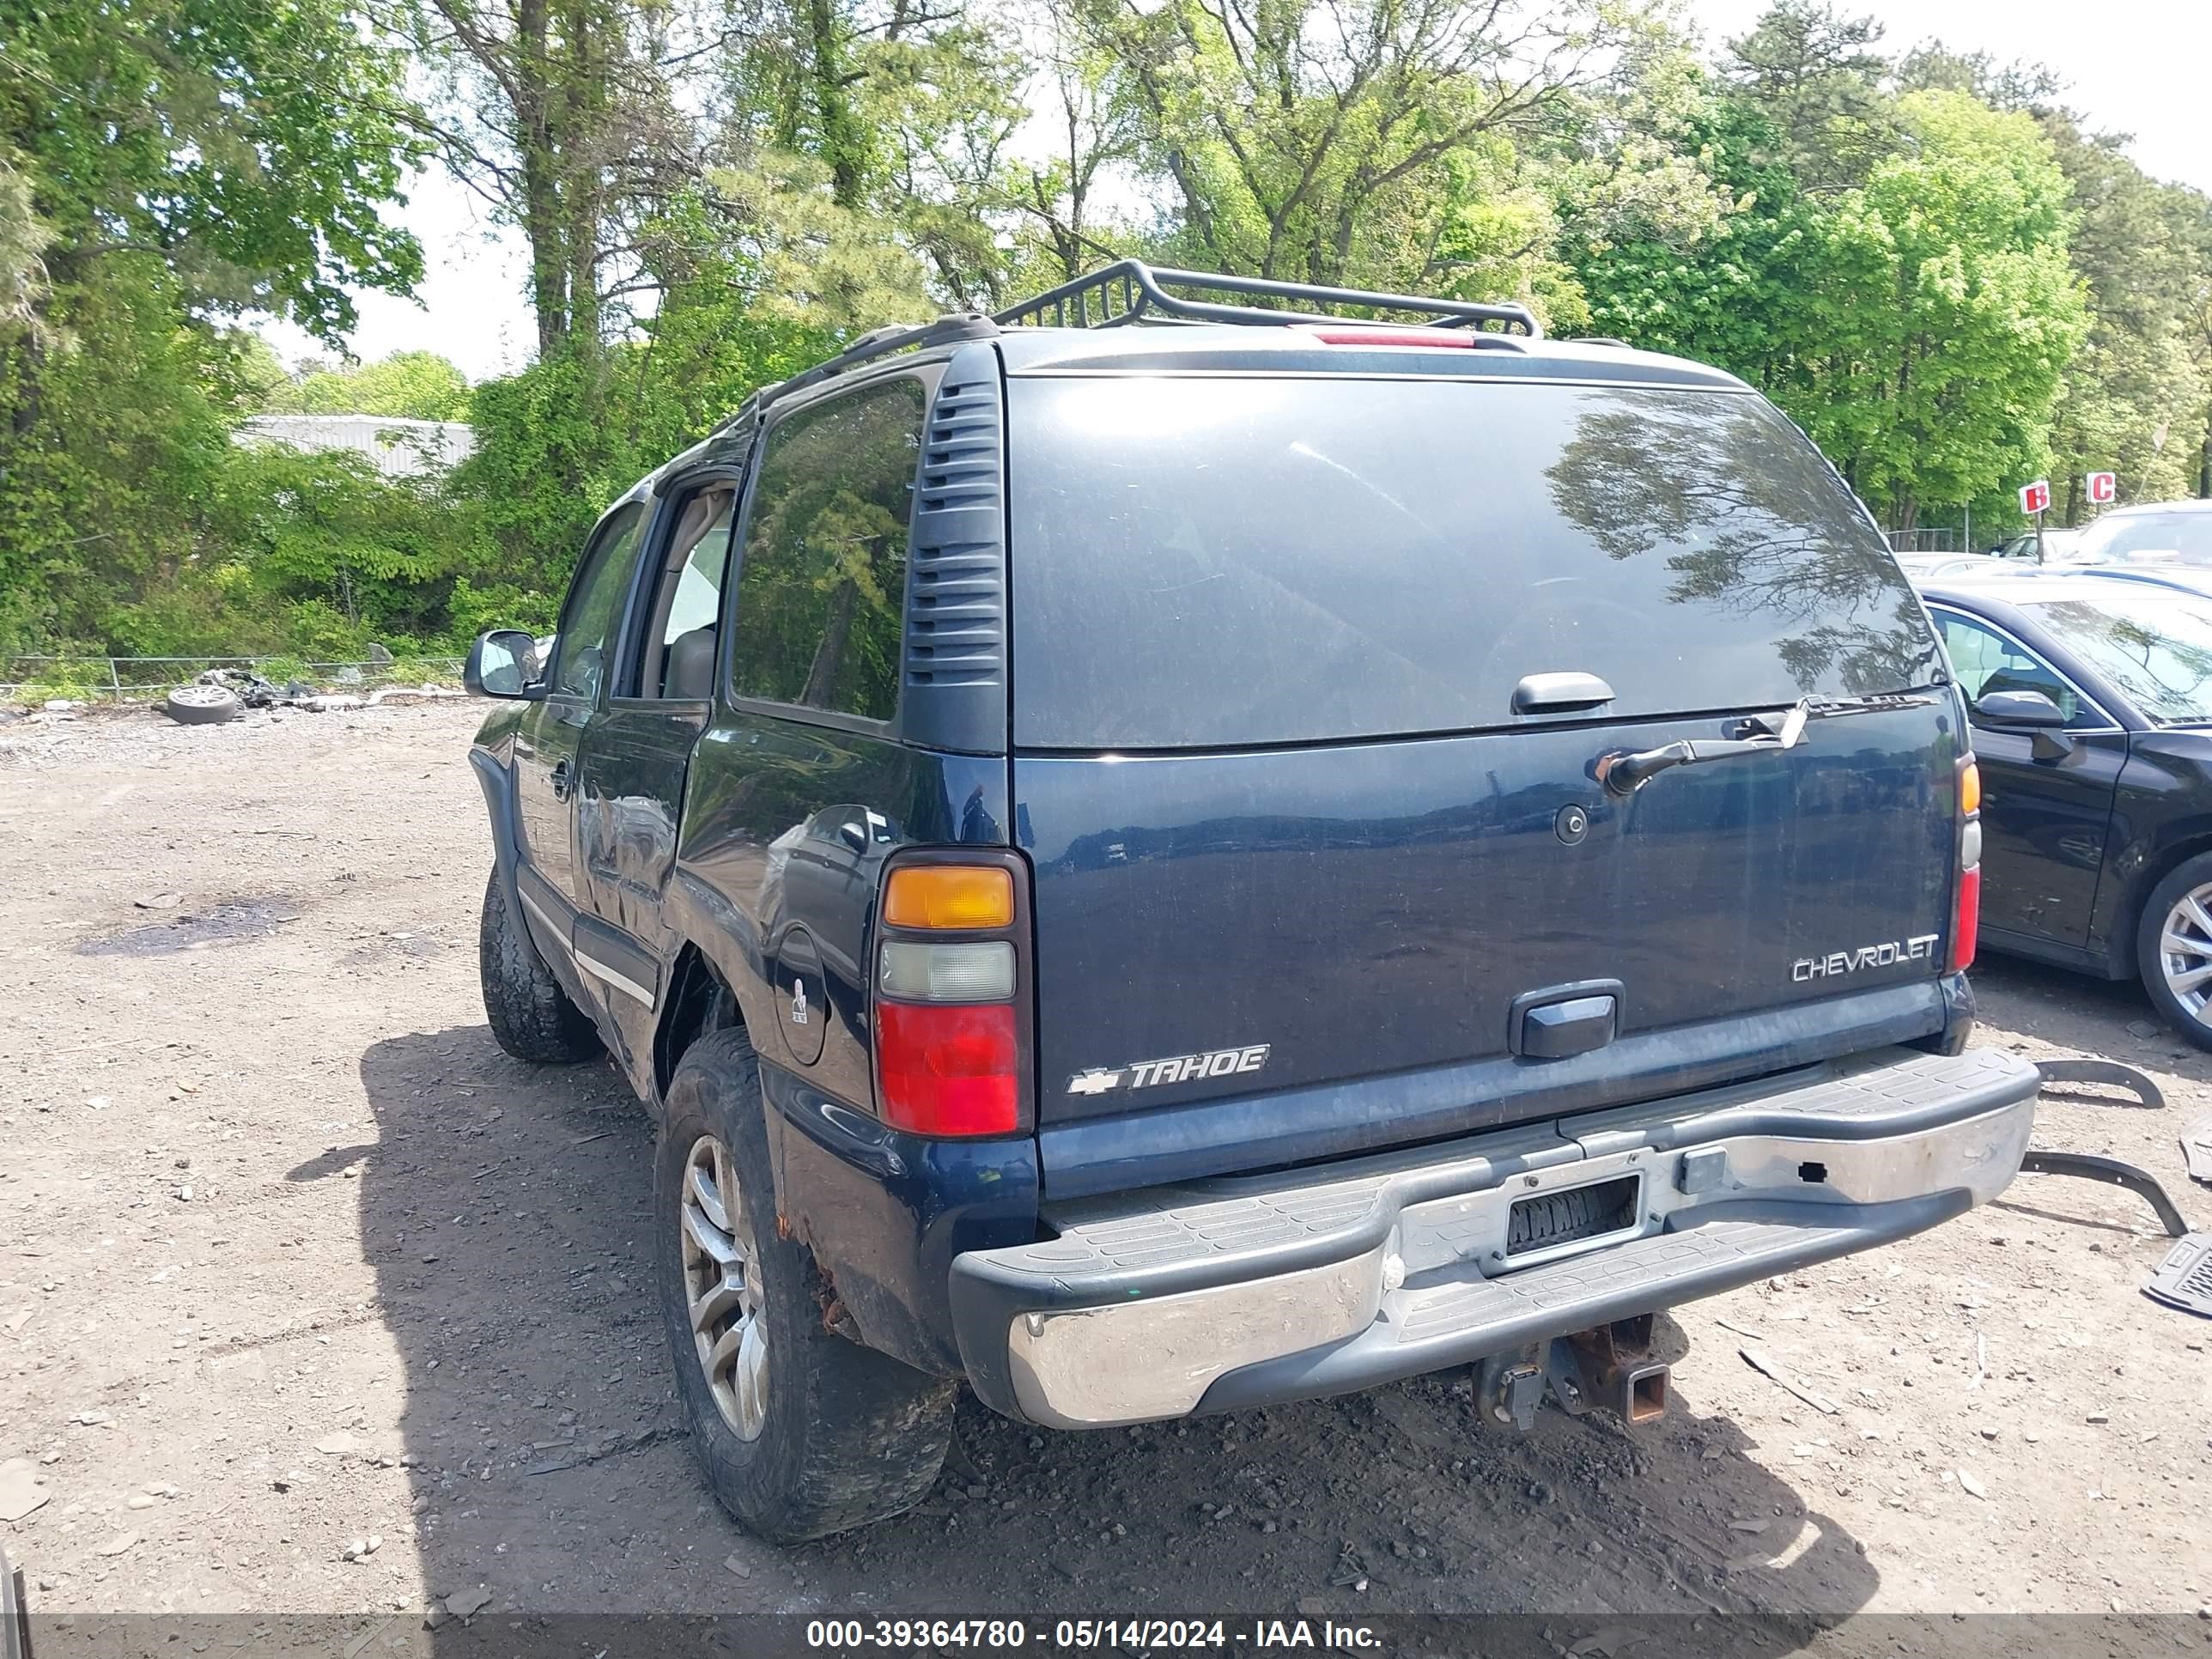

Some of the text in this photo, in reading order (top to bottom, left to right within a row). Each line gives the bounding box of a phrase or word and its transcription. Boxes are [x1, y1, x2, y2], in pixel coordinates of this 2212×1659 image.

[2027, 485, 2048, 511] B
[2094, 475, 2112, 500] C
[1792, 933, 1939, 981] CHEVROLET
[1131, 1047, 1267, 1089] TAHOE
